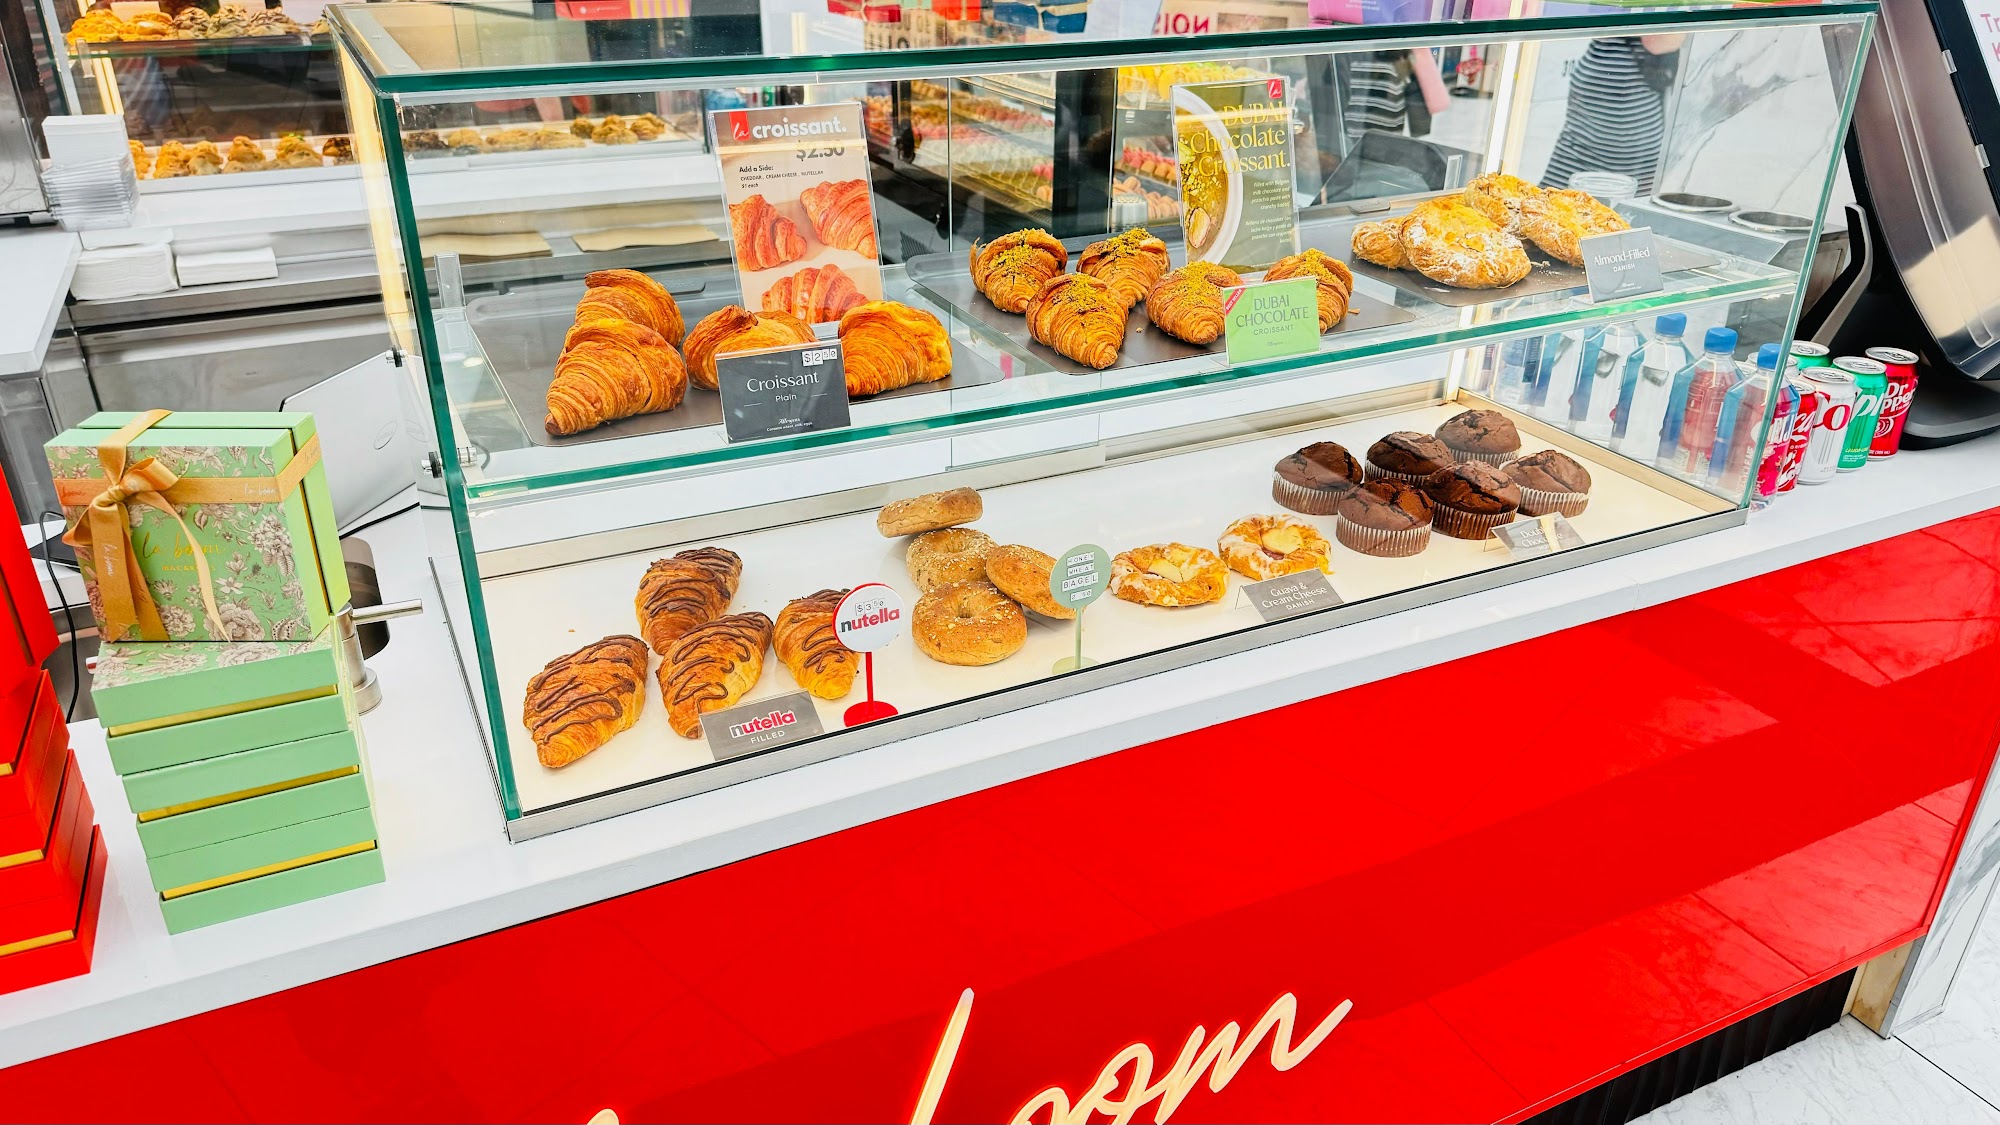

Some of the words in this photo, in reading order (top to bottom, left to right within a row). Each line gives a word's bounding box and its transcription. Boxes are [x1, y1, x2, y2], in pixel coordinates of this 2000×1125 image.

[1223, 101, 1285, 126] DUBAI
[733, 122, 750, 139] la
[752, 117, 847, 139] croissant.
[1190, 125, 1286, 154] Chocolate
[1199, 150, 1290, 177] Croissant.
[1594, 247, 1650, 266] Almond-Filled
[1613, 263, 1636, 272] DANISH
[1254, 294, 1290, 311] DUBAI
[1236, 306, 1309, 328] CHOCOLATE
[1253, 325, 1294, 336] CROISSANT
[746, 371, 820, 393] Croissant
[1884, 382, 1909, 399] Dr
[775, 393, 797, 402] Plain
[174, 531, 224, 560] bom
[1067, 553, 1094, 563] HONEY
[162, 564, 216, 572] MACARS
[1068, 564, 1094, 575] WHEAT
[1063, 574, 1098, 589] BAGEL
[1270, 584, 1299, 597] Guava
[1299, 582, 1308, 590] &
[1262, 596, 1293, 608] Cream
[1292, 587, 1328, 600] Cheese
[1286, 599, 1315, 610] DANISH
[840, 607, 900, 633] nutella
[729, 709, 798, 739] nutella
[751, 730, 786, 744] FILLED
